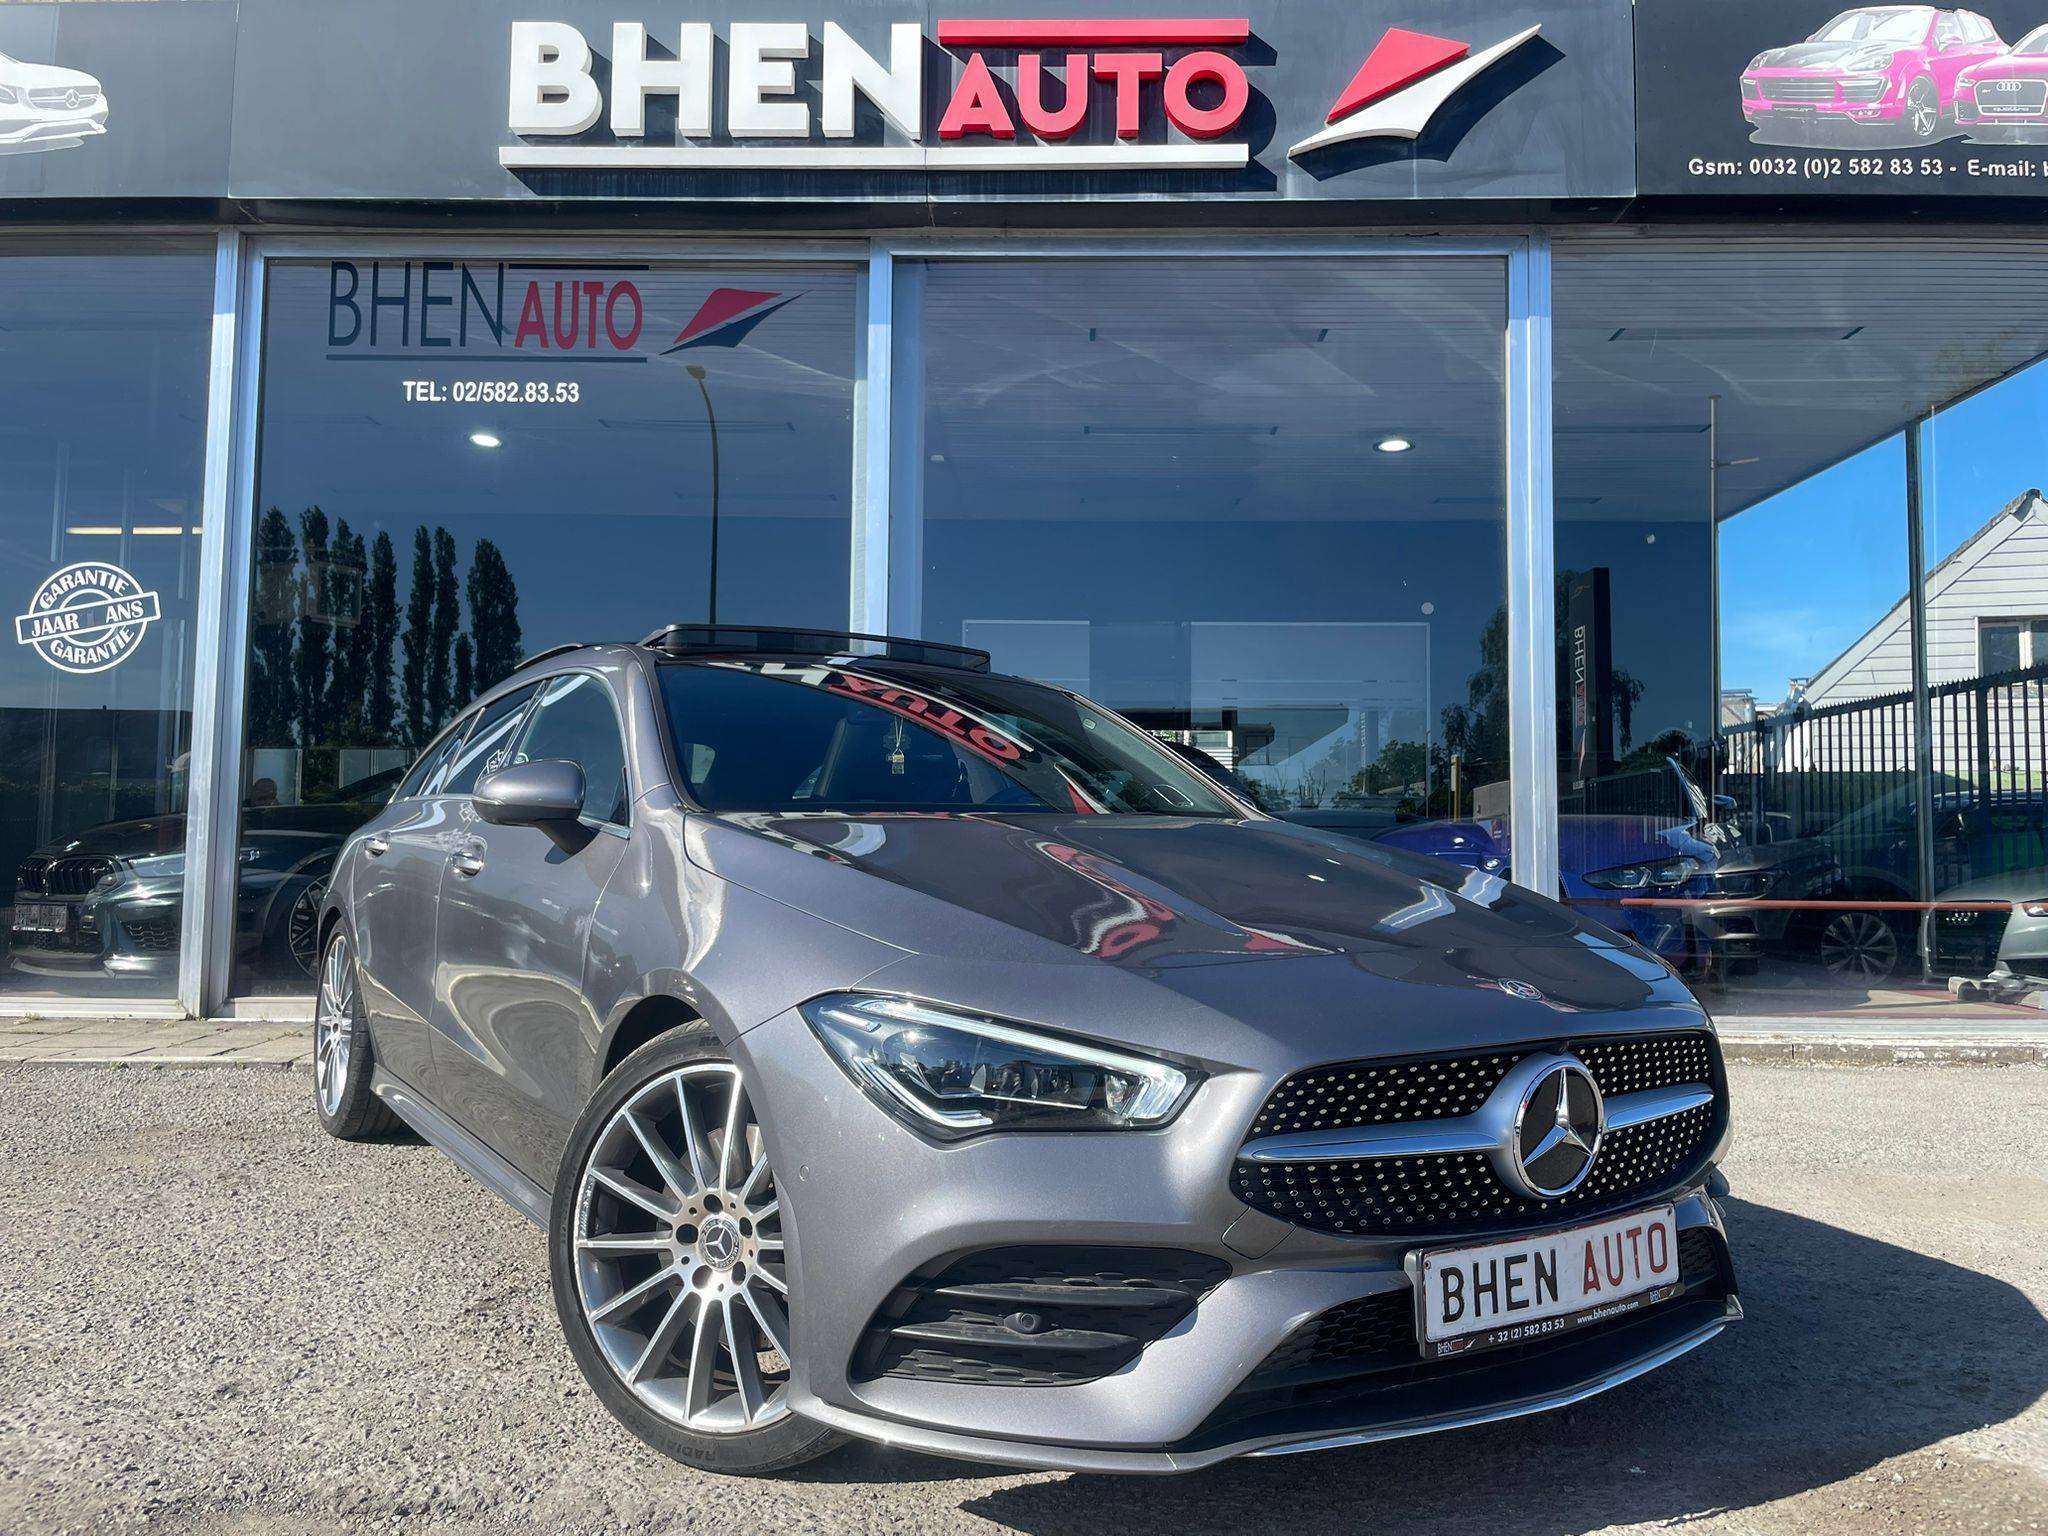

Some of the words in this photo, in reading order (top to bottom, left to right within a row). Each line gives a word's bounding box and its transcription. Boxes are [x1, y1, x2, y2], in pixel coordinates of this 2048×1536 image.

[507, 21, 922, 141] BHEN
[937, 51, 1250, 140] AUTO
[1688, 158, 1743, 176] Gsm:
[1750, 158, 1797, 175] 0032
[1804, 158, 1842, 179] (0)2
[1849, 158, 1884, 175] 582
[1890, 158, 1914, 175] 83
[1920, 158, 1943, 175] 53
[1967, 159, 2036, 177] E-mail:
[328, 260, 505, 347] BHEN
[514, 279, 644, 351] AUTO
[402, 381, 448, 402] TEL:
[453, 381, 580, 403] 02/582.83.53
[39, 569, 129, 610] GARANTIE
[31, 612, 80, 638] JAAR
[105, 600, 145, 624] ANS
[50, 624, 135, 665] GARANTIE
[1440, 1248, 1559, 1324] BHEN
[1583, 1222, 1669, 1295] AUTO
[1497, 1330, 1509, 1343] 32
[1510, 1326, 1522, 1340] (2)
[1524, 1323, 1541, 1337] 582
[1541, 1320, 1553, 1333] 83
[1554, 1318, 1565, 1330] 53
[1577, 1301, 1639, 1324] www.bhenauto.com
